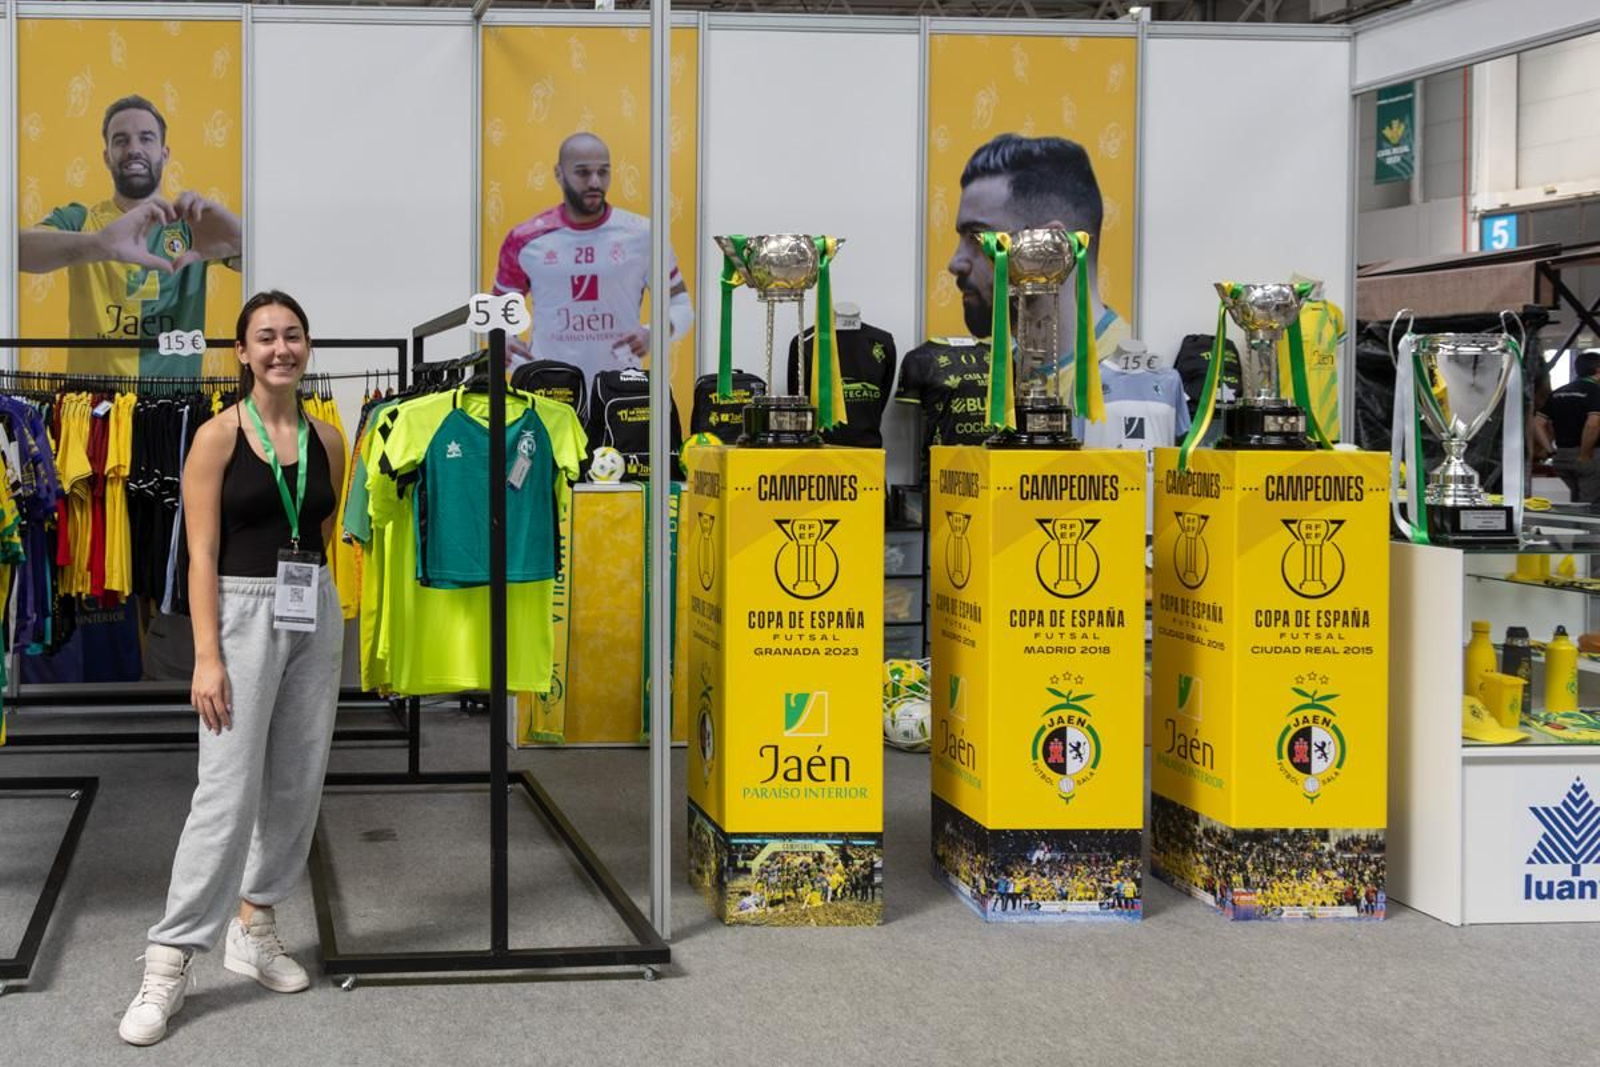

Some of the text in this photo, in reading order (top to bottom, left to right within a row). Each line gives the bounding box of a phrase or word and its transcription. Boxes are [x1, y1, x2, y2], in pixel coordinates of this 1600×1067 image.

[1492, 219, 1509, 250] 5
[574, 247, 595, 264] 28
[105, 304, 175, 336] Jaén
[474, 299, 521, 326] 5 €
[556, 307, 614, 333] Jaén
[163, 335, 203, 351] 15 €
[1122, 355, 1160, 371] 15 €
[758, 474, 858, 501] CAMPEONES
[939, 468, 980, 498] CAMPEONES
[1019, 474, 1119, 501] CAMPEONES
[1165, 469, 1221, 499] CAMPEONES
[1265, 475, 1364, 501] CAMPEONES
[748, 608, 865, 629] COPA DE ESPAÑA
[1009, 607, 1125, 628] COPA DE ESPAÑA
[1192, 600, 1224, 624] ESPAÑA
[1255, 607, 1370, 628] COPA DE ESPAÑA
[772, 633, 841, 641] FUTSAL
[1034, 632, 1100, 640] FUTSAL
[1280, 632, 1345, 640] FUTSAL
[754, 647, 859, 656] GRANADA 2023
[1023, 646, 1111, 654] MADRID 2018
[1251, 646, 1374, 655] CIUDAD REAL 2015
[1048, 715, 1087, 728] JAEN
[1293, 715, 1332, 728] JAEN
[939, 719, 976, 771] Jaén
[1164, 718, 1214, 770] Jaén
[759, 744, 850, 784] Jaén
[804, 787, 868, 799] INTERIOR
[1524, 873, 1600, 901] luan
